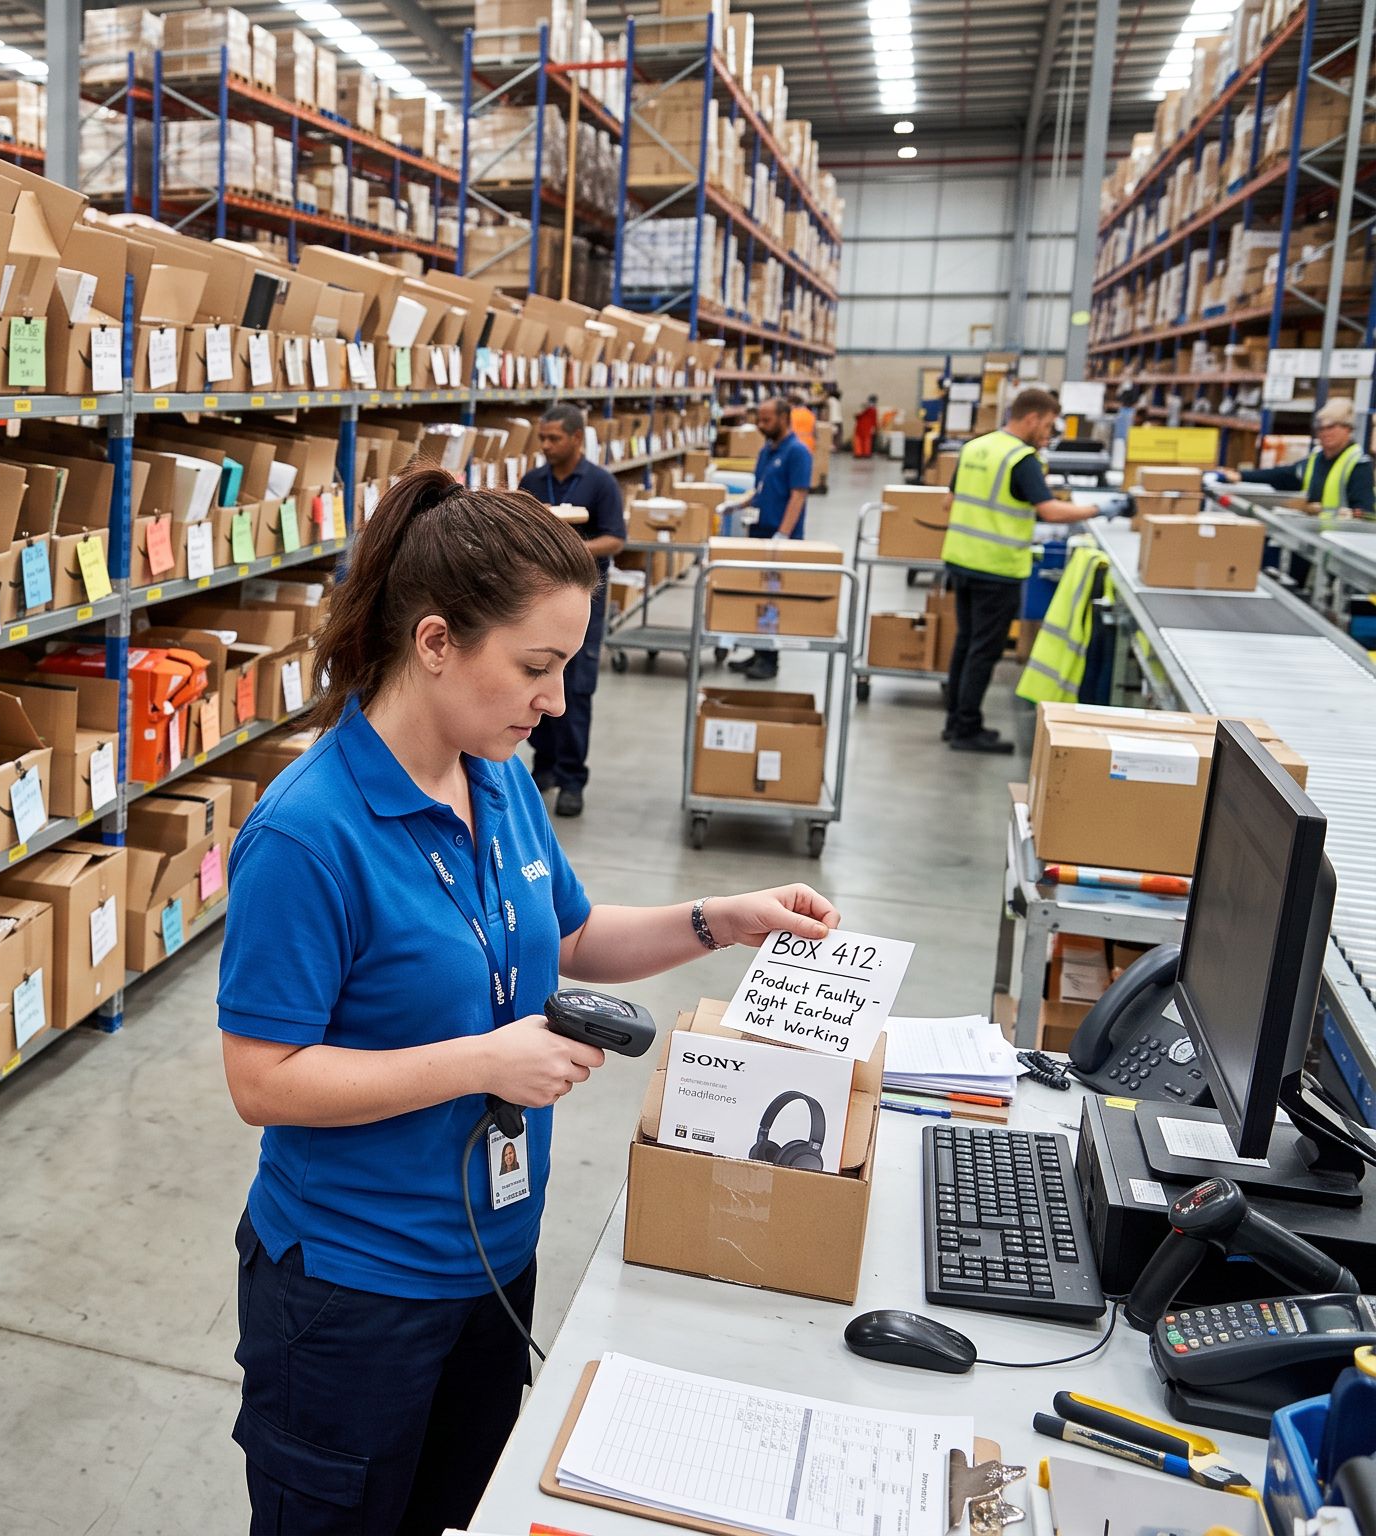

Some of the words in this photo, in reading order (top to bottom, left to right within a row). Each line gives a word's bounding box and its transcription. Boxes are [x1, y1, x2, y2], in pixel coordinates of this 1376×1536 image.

[831, 942, 883, 971] 412:
[744, 989, 788, 1014] Right
[794, 1001, 854, 1026] Earbud
[750, 969, 810, 995] Product
[815, 983, 867, 1012] Faulty
[745, 1011, 775, 1027] Not
[783, 1022, 850, 1052] Working
[682, 1051, 746, 1072] SONY
